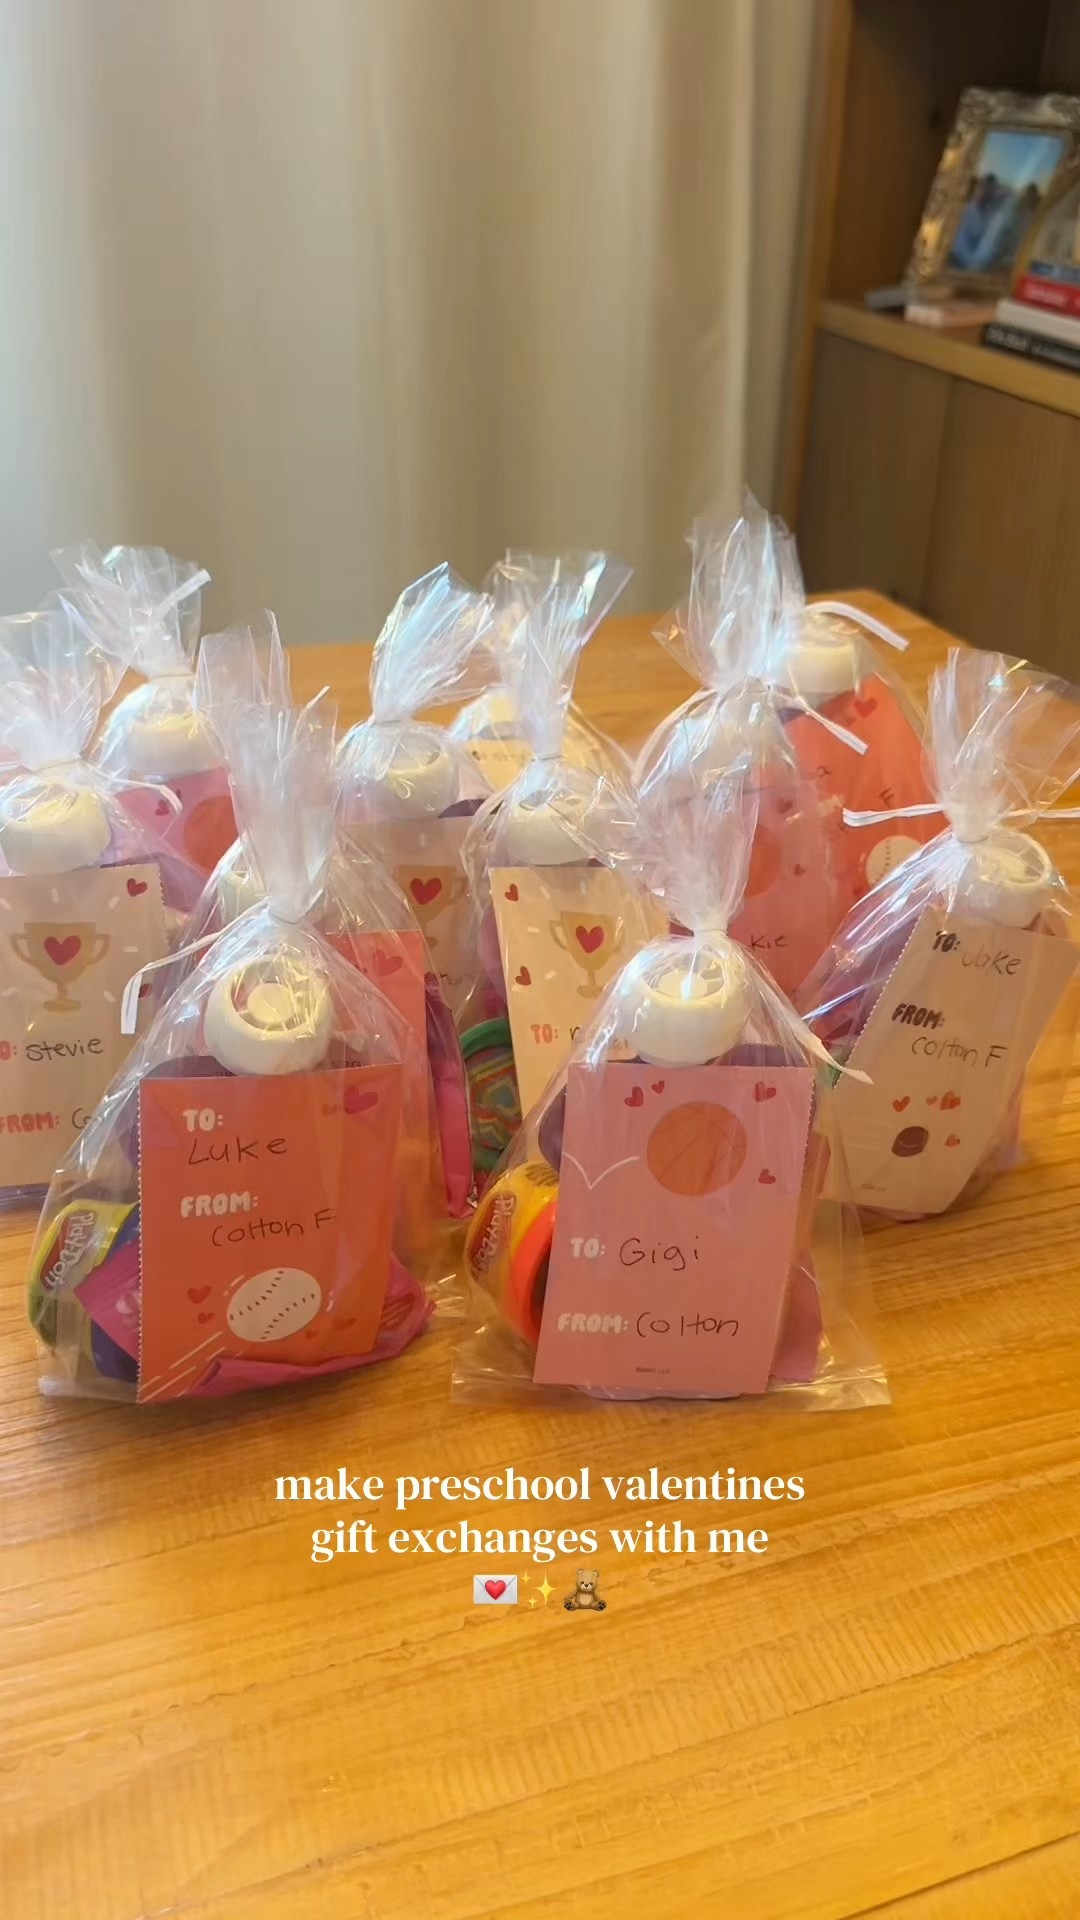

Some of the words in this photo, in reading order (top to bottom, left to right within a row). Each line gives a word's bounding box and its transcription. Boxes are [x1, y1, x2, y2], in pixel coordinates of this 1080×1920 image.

[891, 1003, 945, 1030] FROM:
[530, 1024, 559, 1044] TO:
[0, 1040, 18, 1061] O:
[984, 1044, 1009, 1068] F
[182, 1108, 224, 1132] TO:
[180, 1192, 258, 1219] FROM:
[313, 1207, 338, 1230] F
[570, 1237, 606, 1259] TO:
[619, 1235, 700, 1271] Gigi
[557, 1312, 629, 1333] FROM:
